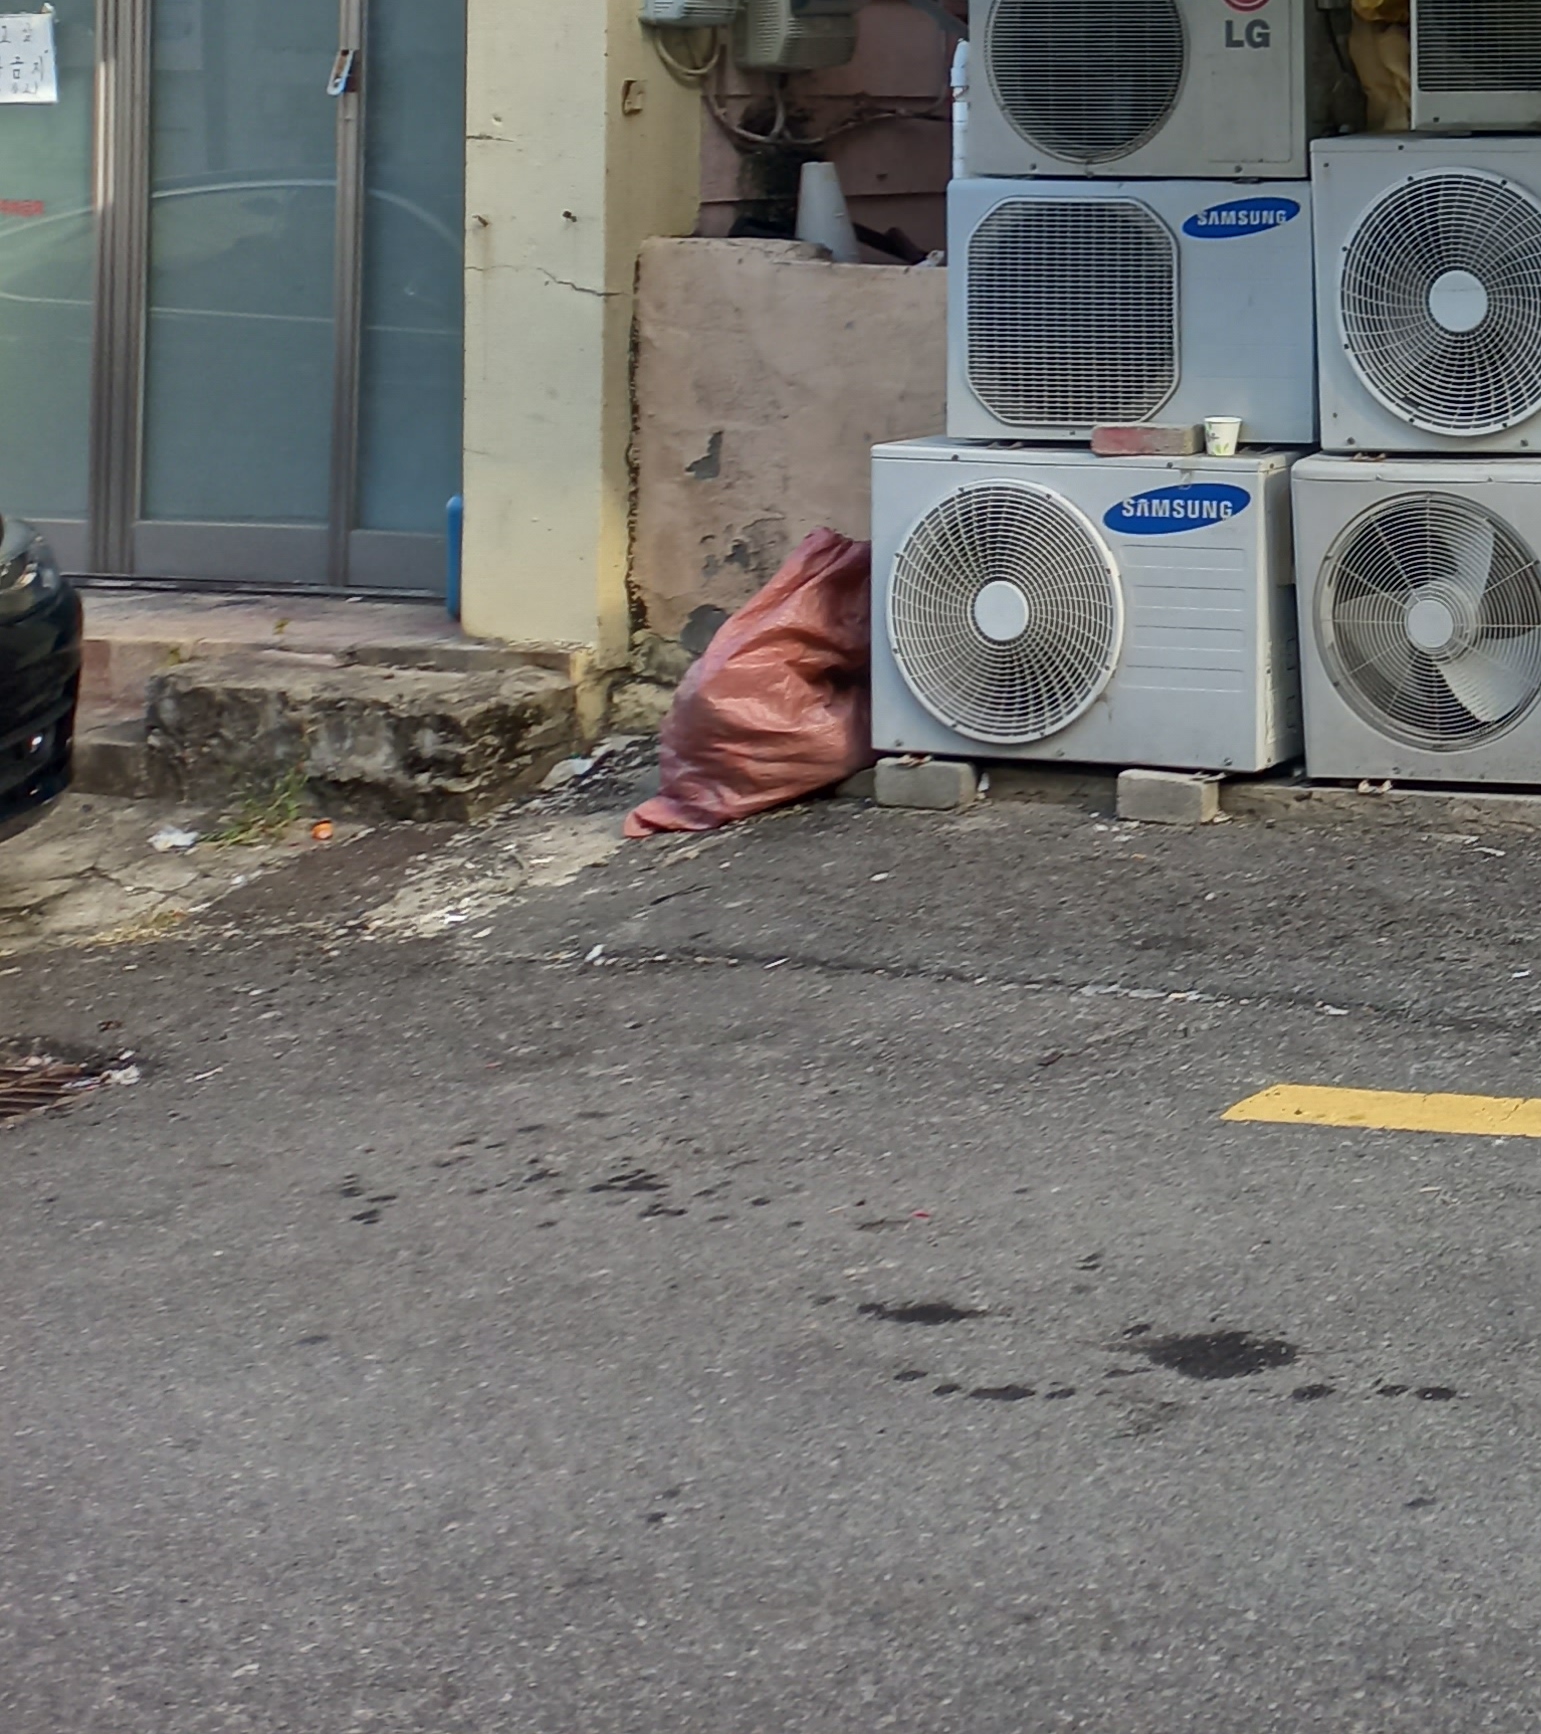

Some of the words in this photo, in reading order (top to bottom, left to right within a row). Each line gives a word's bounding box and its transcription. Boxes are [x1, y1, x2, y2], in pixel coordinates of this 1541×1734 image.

[1224, 20, 1271, 49] LG
[1195, 207, 1288, 229] SAMSUNG
[1120, 497, 1234, 522] SAMSUNG
